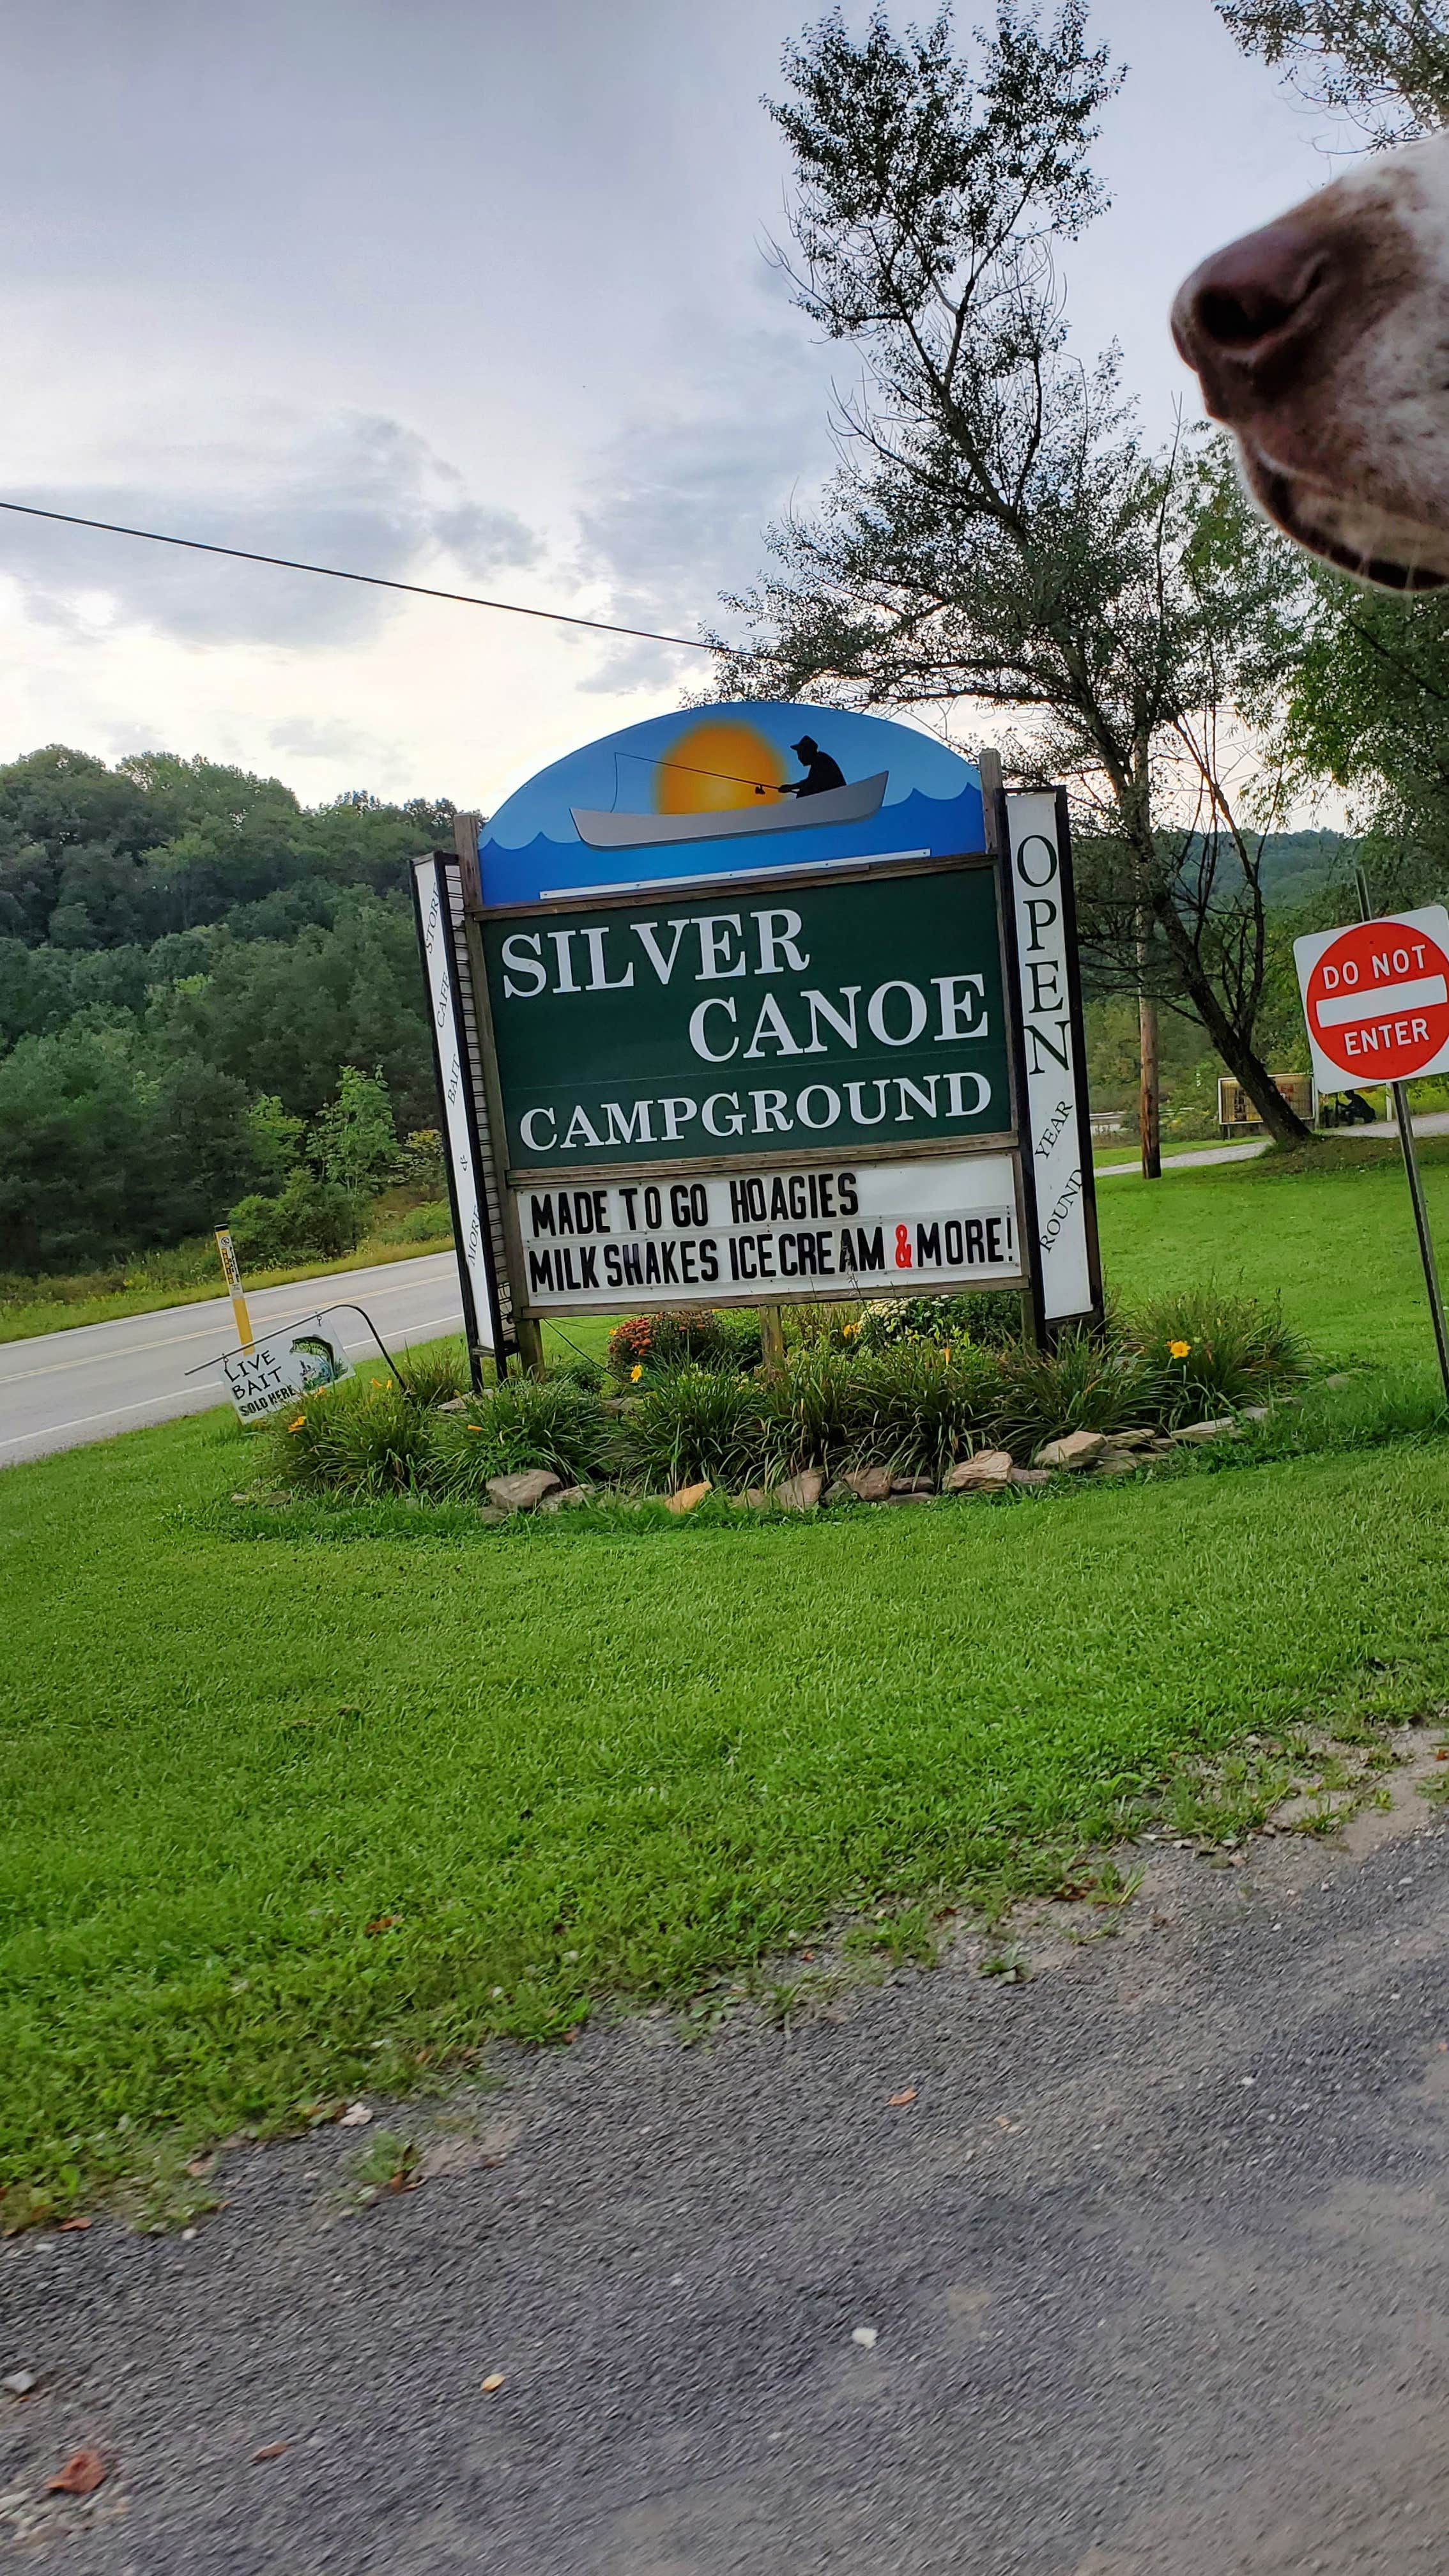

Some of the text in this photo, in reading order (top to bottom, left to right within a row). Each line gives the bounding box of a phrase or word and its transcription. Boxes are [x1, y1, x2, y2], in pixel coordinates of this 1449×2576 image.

[502, 909, 810, 998] SILVER
[1016, 834, 1071, 1076] OPEN
[1322, 944, 1425, 990] DO NOT
[689, 974, 988, 1062] CANOE
[1344, 1018, 1429, 1055] ENTER
[448, 1054, 460, 1108] BAIT
[519, 1072, 991, 1150] CAMPGROUND
[1034, 1100, 1073, 1160] YEAR
[530, 1172, 859, 1238] MADE TO GO HOAGIES
[1039, 1169, 1082, 1254] ROUND
[224, 1349, 276, 1383] LIVE
[231, 1365, 282, 1400] BAIT
[239, 1385, 296, 1416] SOLD HERE
